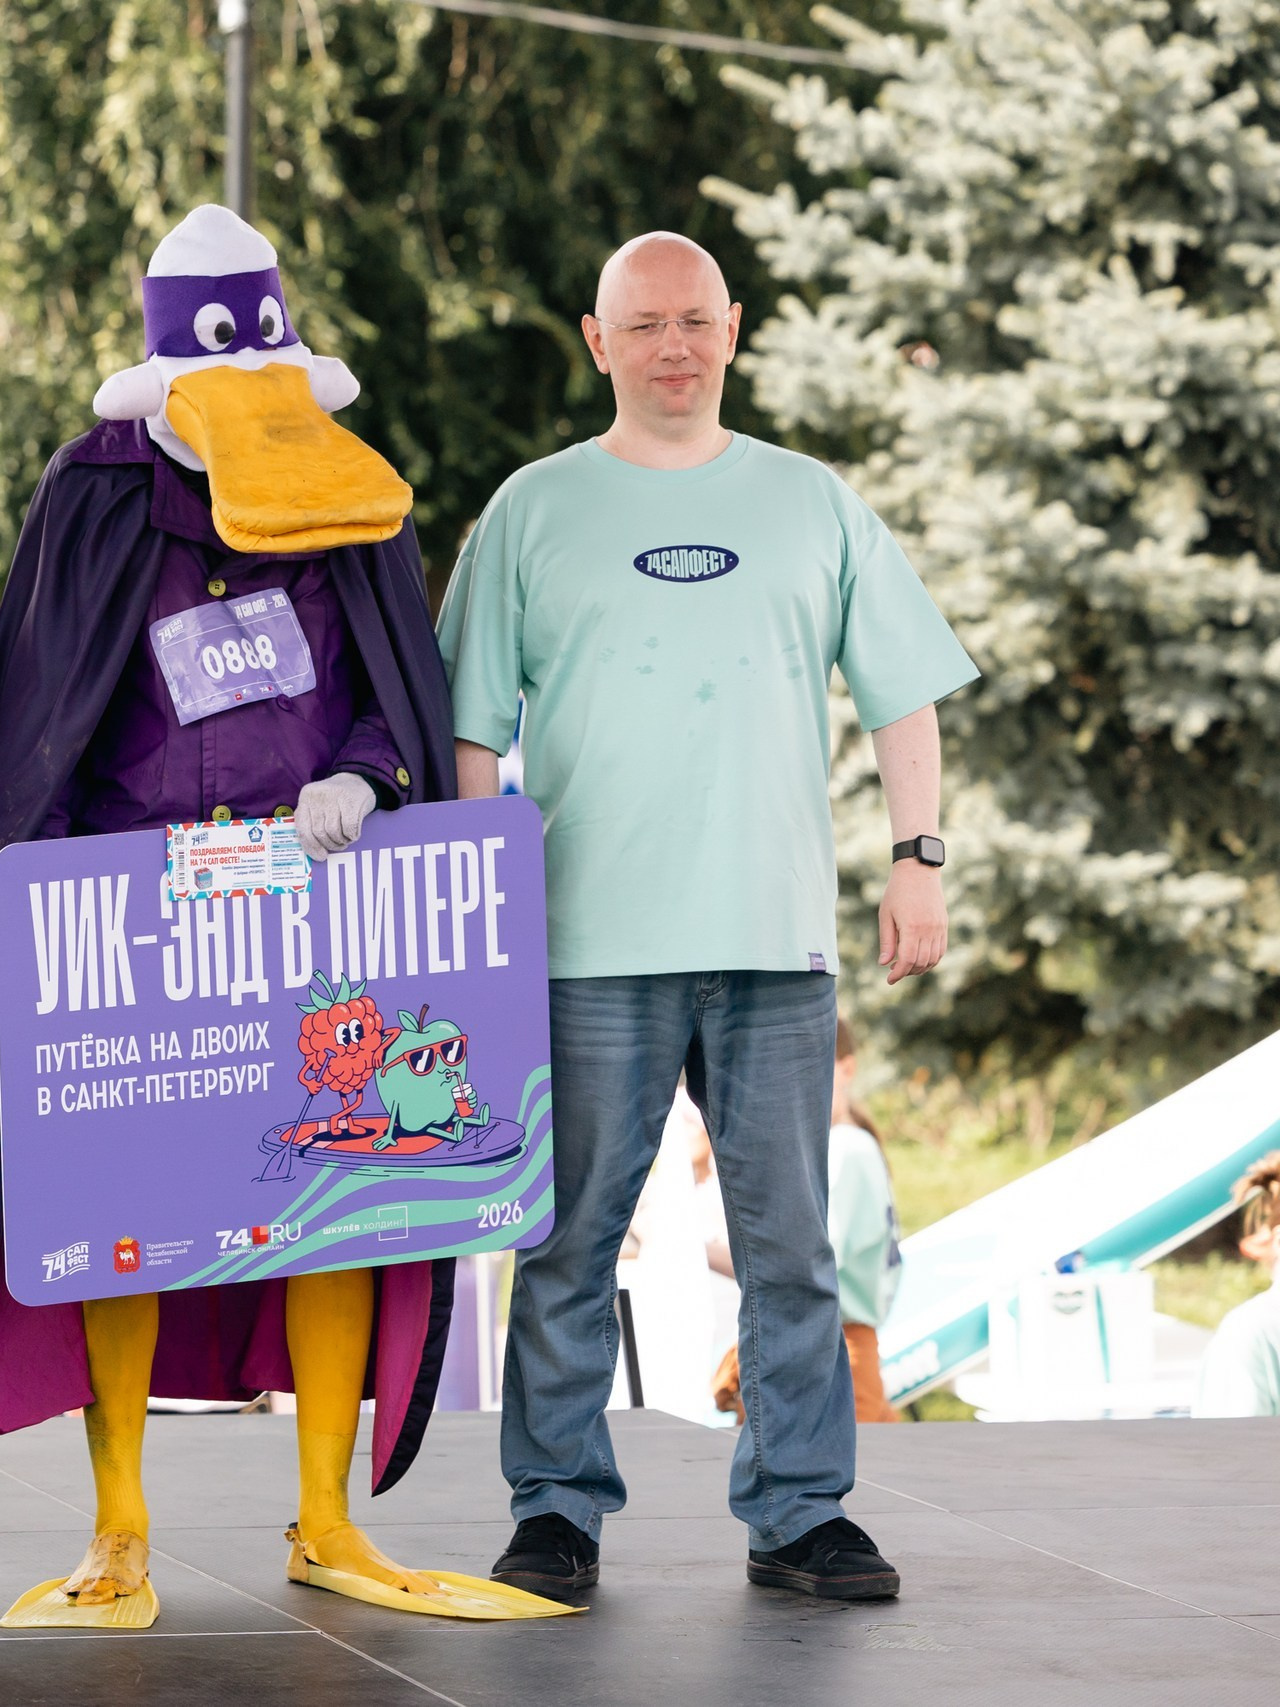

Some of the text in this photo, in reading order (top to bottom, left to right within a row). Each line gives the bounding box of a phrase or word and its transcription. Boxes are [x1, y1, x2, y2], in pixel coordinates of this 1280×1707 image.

[645, 548, 727, 579] 74САПФЕСТ
[157, 626, 172, 643] 74
[202, 634, 277, 680] 0888
[190, 846, 233, 857] ПОЗДРАВЛЯЕМ
[233, 846, 237, 854] С
[238, 843, 266, 854] ПОБЕДОЙ
[190, 858, 198, 866] НА
[199, 858, 207, 866] 74
[208, 857, 219, 865] САП
[219, 856, 240, 864] ФЕСТЕ!
[28, 836, 510, 1015] УИК-ЭНД В ПИТЕРЕ
[35, 1020, 271, 1074] ПУТЁВКА НА ДВОИХ
[37, 1062, 275, 1116] В САНКТ-ПЕТЕРБУРГ
[477, 1200, 524, 1229] 2026
[323, 1218, 405, 1235] ШКУЛЁВ ХОЛДИНГ
[216, 1221, 302, 1250] 74 RU
[67, 1244, 89, 1258] САП
[146, 1239, 194, 1251] Правительство
[146, 1247, 188, 1258] Челябинской
[218, 1243, 285, 1257] ЧЕЛЯБИНСК ОНЛАЙН
[42, 1252, 65, 1280] 74
[67, 1254, 89, 1267] ФЕСТ
[146, 1257, 172, 1266] области
